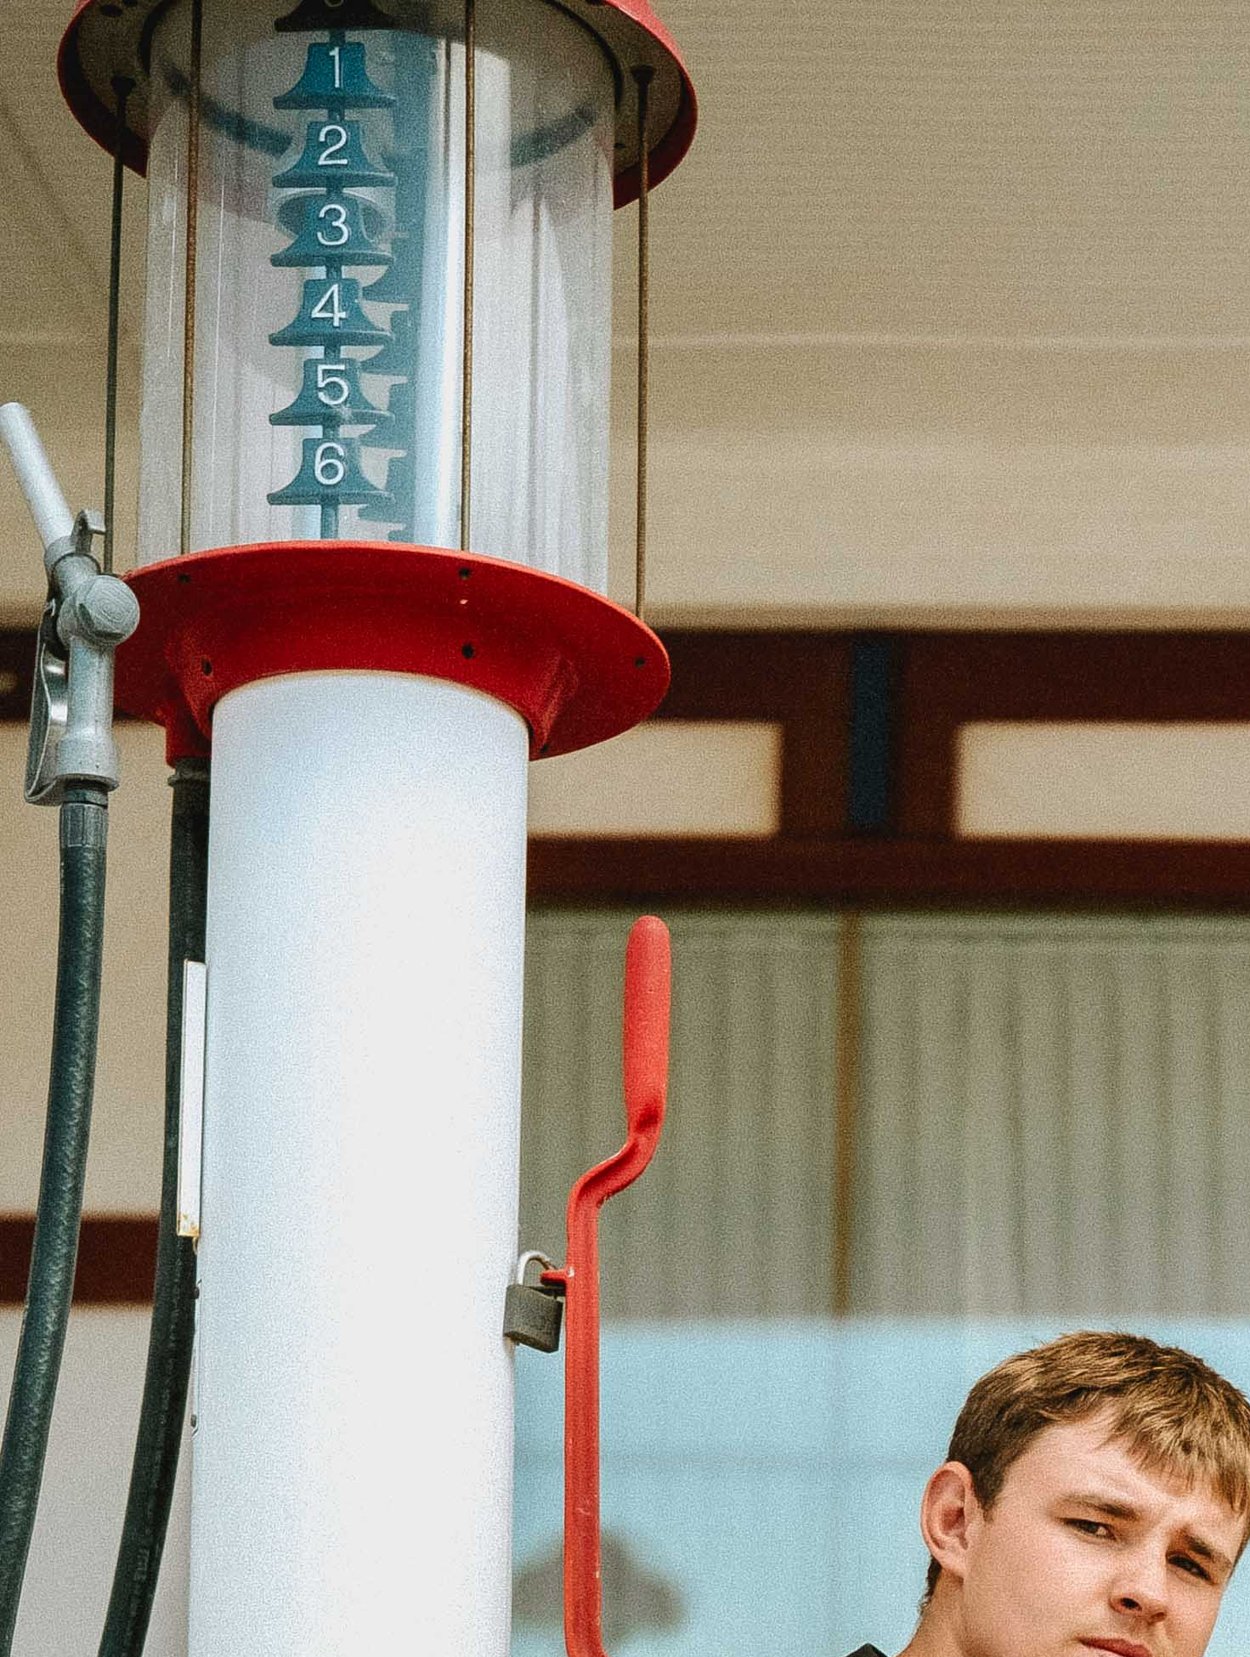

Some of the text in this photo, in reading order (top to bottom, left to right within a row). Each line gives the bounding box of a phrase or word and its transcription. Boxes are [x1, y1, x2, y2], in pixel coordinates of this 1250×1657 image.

[329, 46, 340, 89] 1
[317, 124, 348, 166] 2
[316, 203, 349, 246] 3
[310, 283, 347, 328] 4
[316, 363, 350, 406] 5
[313, 441, 346, 486] 6
